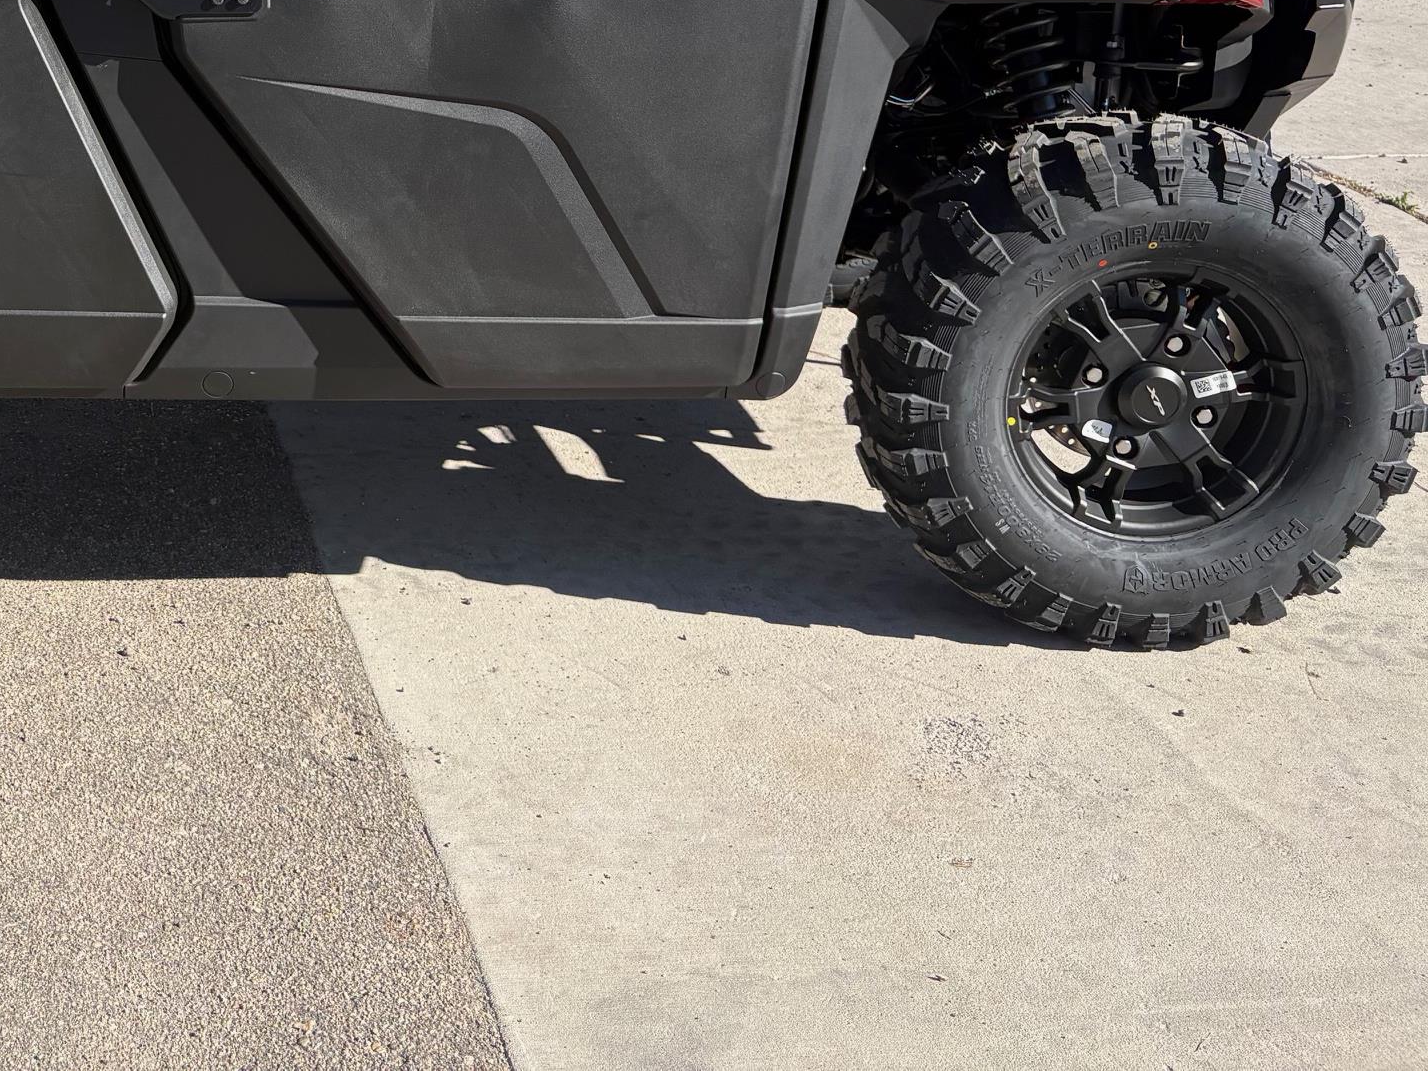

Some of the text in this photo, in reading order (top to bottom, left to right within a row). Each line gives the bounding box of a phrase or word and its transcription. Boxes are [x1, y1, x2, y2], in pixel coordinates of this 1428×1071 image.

[1024, 220, 1212, 298] X-TERRAIN
[1145, 385, 1165, 416] XP
[1152, 518, 1309, 592] PRO ARMOR
